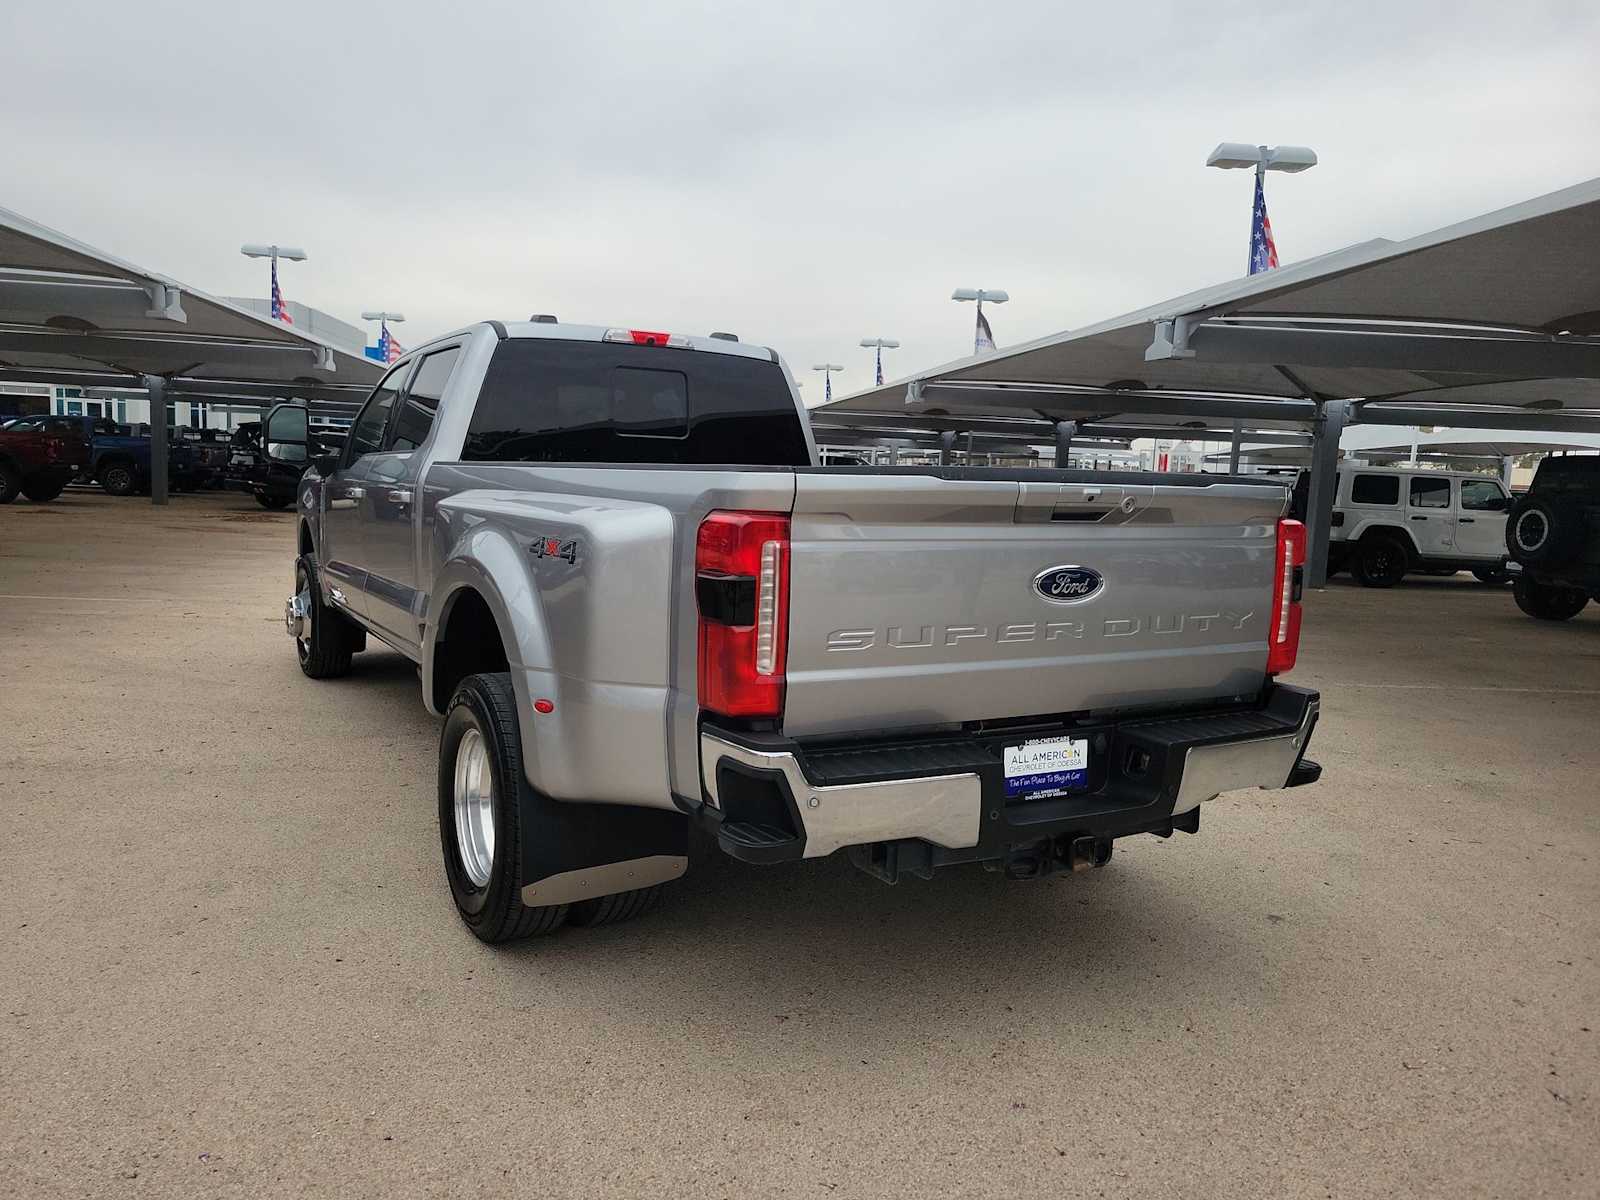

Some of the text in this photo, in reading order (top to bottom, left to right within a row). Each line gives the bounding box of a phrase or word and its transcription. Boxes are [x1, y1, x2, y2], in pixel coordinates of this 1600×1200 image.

[1050, 572, 1089, 596] Ford
[826, 610, 1256, 652] SUPER DUTY
[1008, 758, 1082, 774] CHEVROLET OF ODESSA
[1011, 755, 1029, 765] ALL
[1009, 779, 1020, 788] The
[1020, 778, 1031, 787] Fun
[1031, 775, 1045, 785] Place
[1046, 774, 1053, 783] To
[1054, 774, 1065, 784] Buy
[1070, 771, 1081, 780] Car
